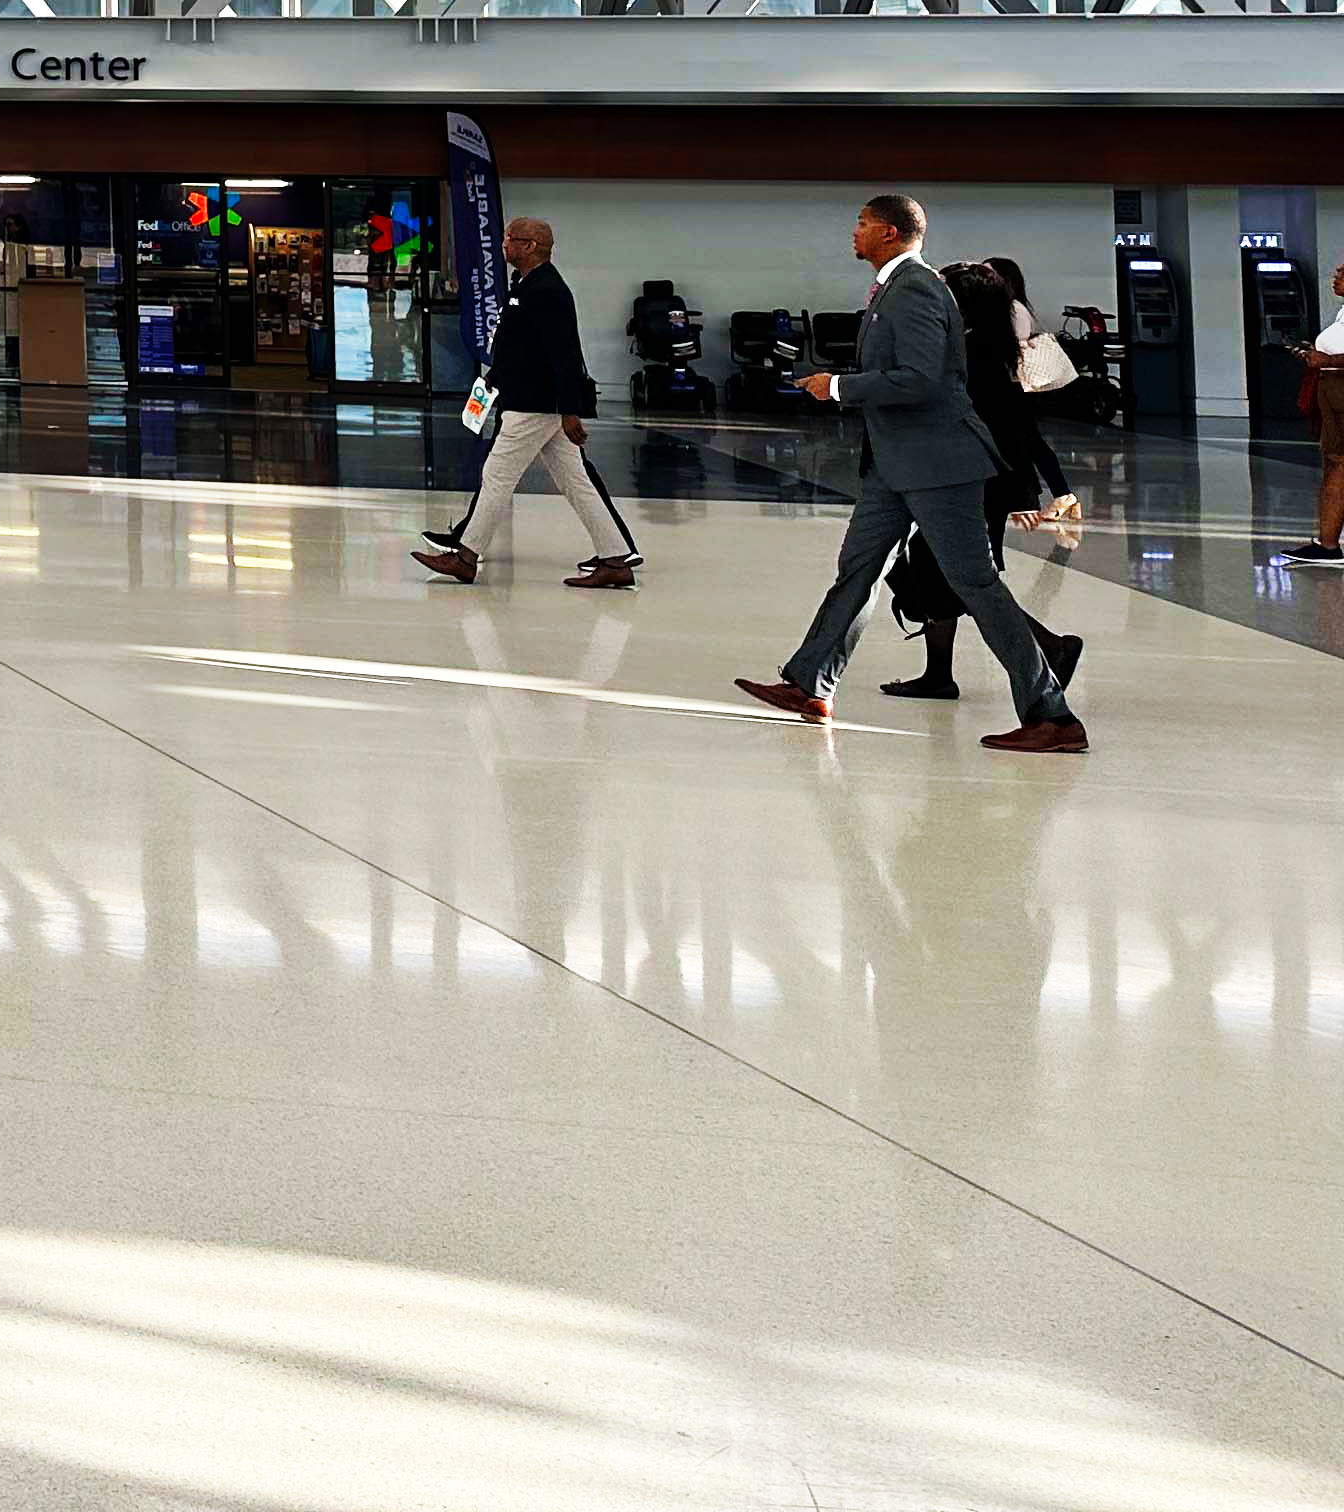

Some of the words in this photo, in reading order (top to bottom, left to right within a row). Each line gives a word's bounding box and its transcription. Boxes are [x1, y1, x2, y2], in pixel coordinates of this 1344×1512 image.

[12, 48, 146, 80] Center
[171, 220, 201, 232] Office
[1114, 234, 1151, 246] ATM
[1240, 235, 1278, 247] ATM
